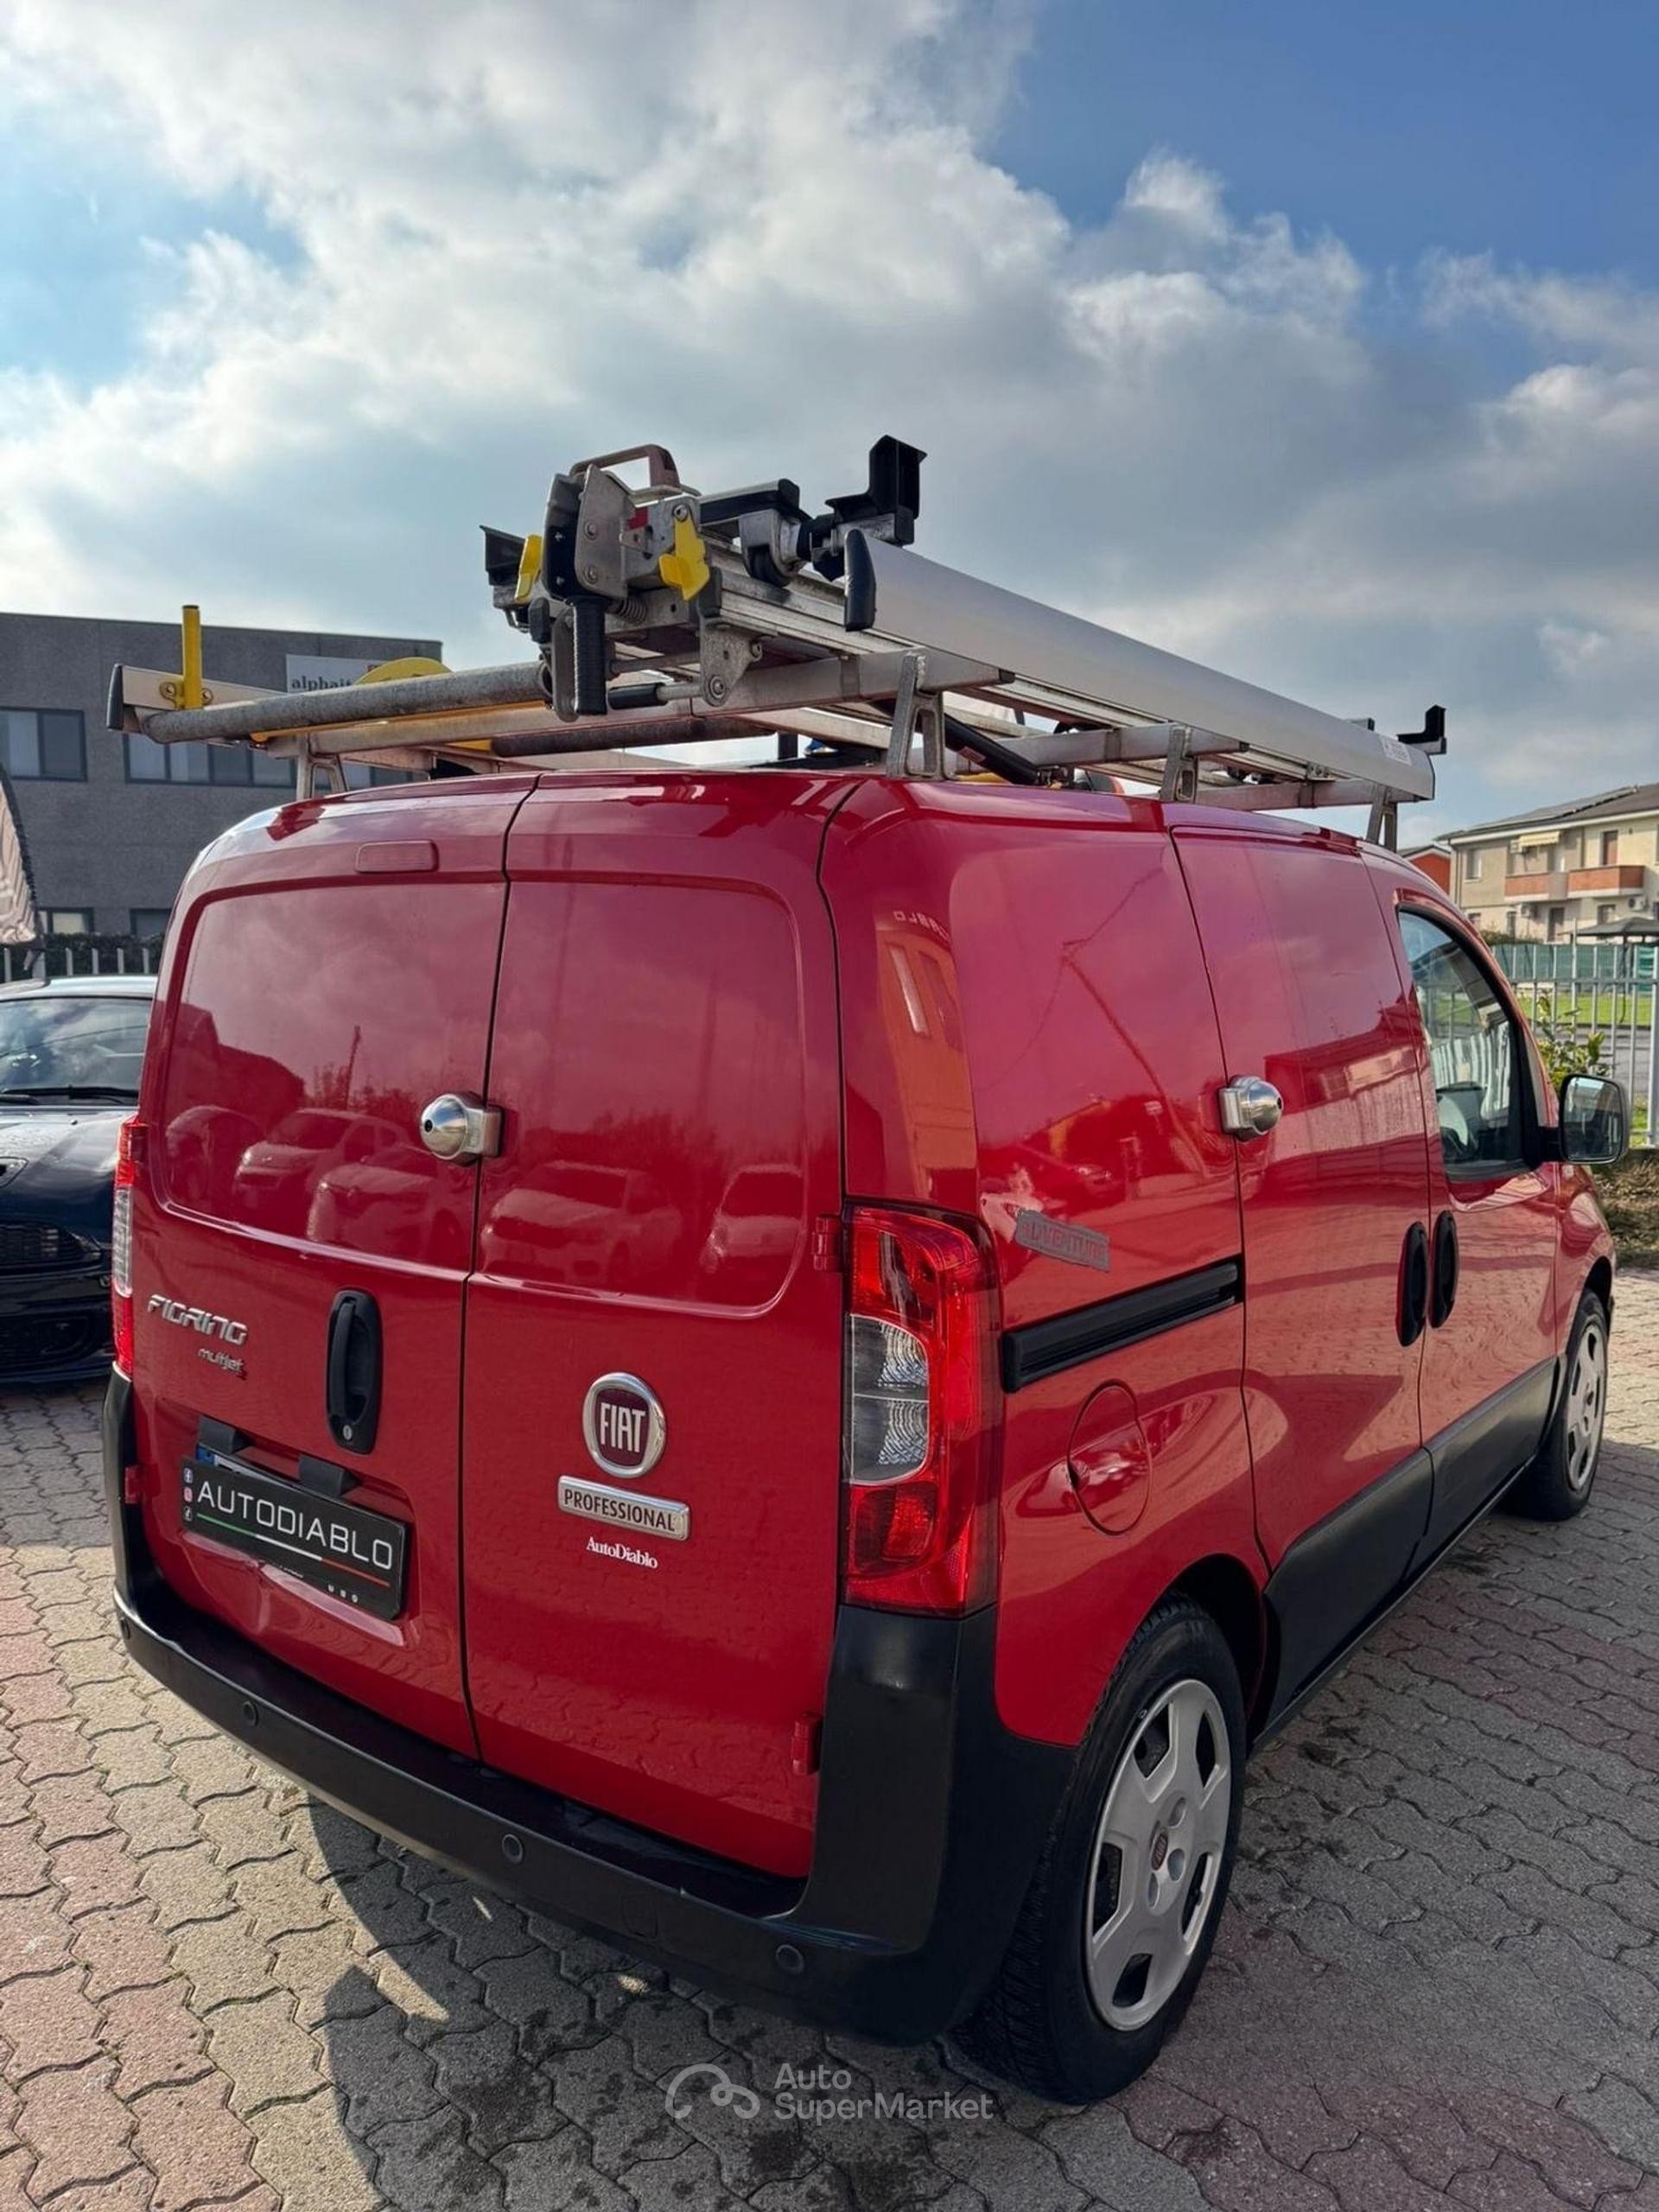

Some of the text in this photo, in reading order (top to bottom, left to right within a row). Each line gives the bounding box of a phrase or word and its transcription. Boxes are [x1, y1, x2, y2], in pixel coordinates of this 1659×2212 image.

[600, 1402, 646, 1453] FIAT
[196, 1480, 393, 1570] AUTODIABLO
[563, 1488, 676, 1532] PROFESSIONAL
[585, 1535, 659, 1569] AutoDiablo
